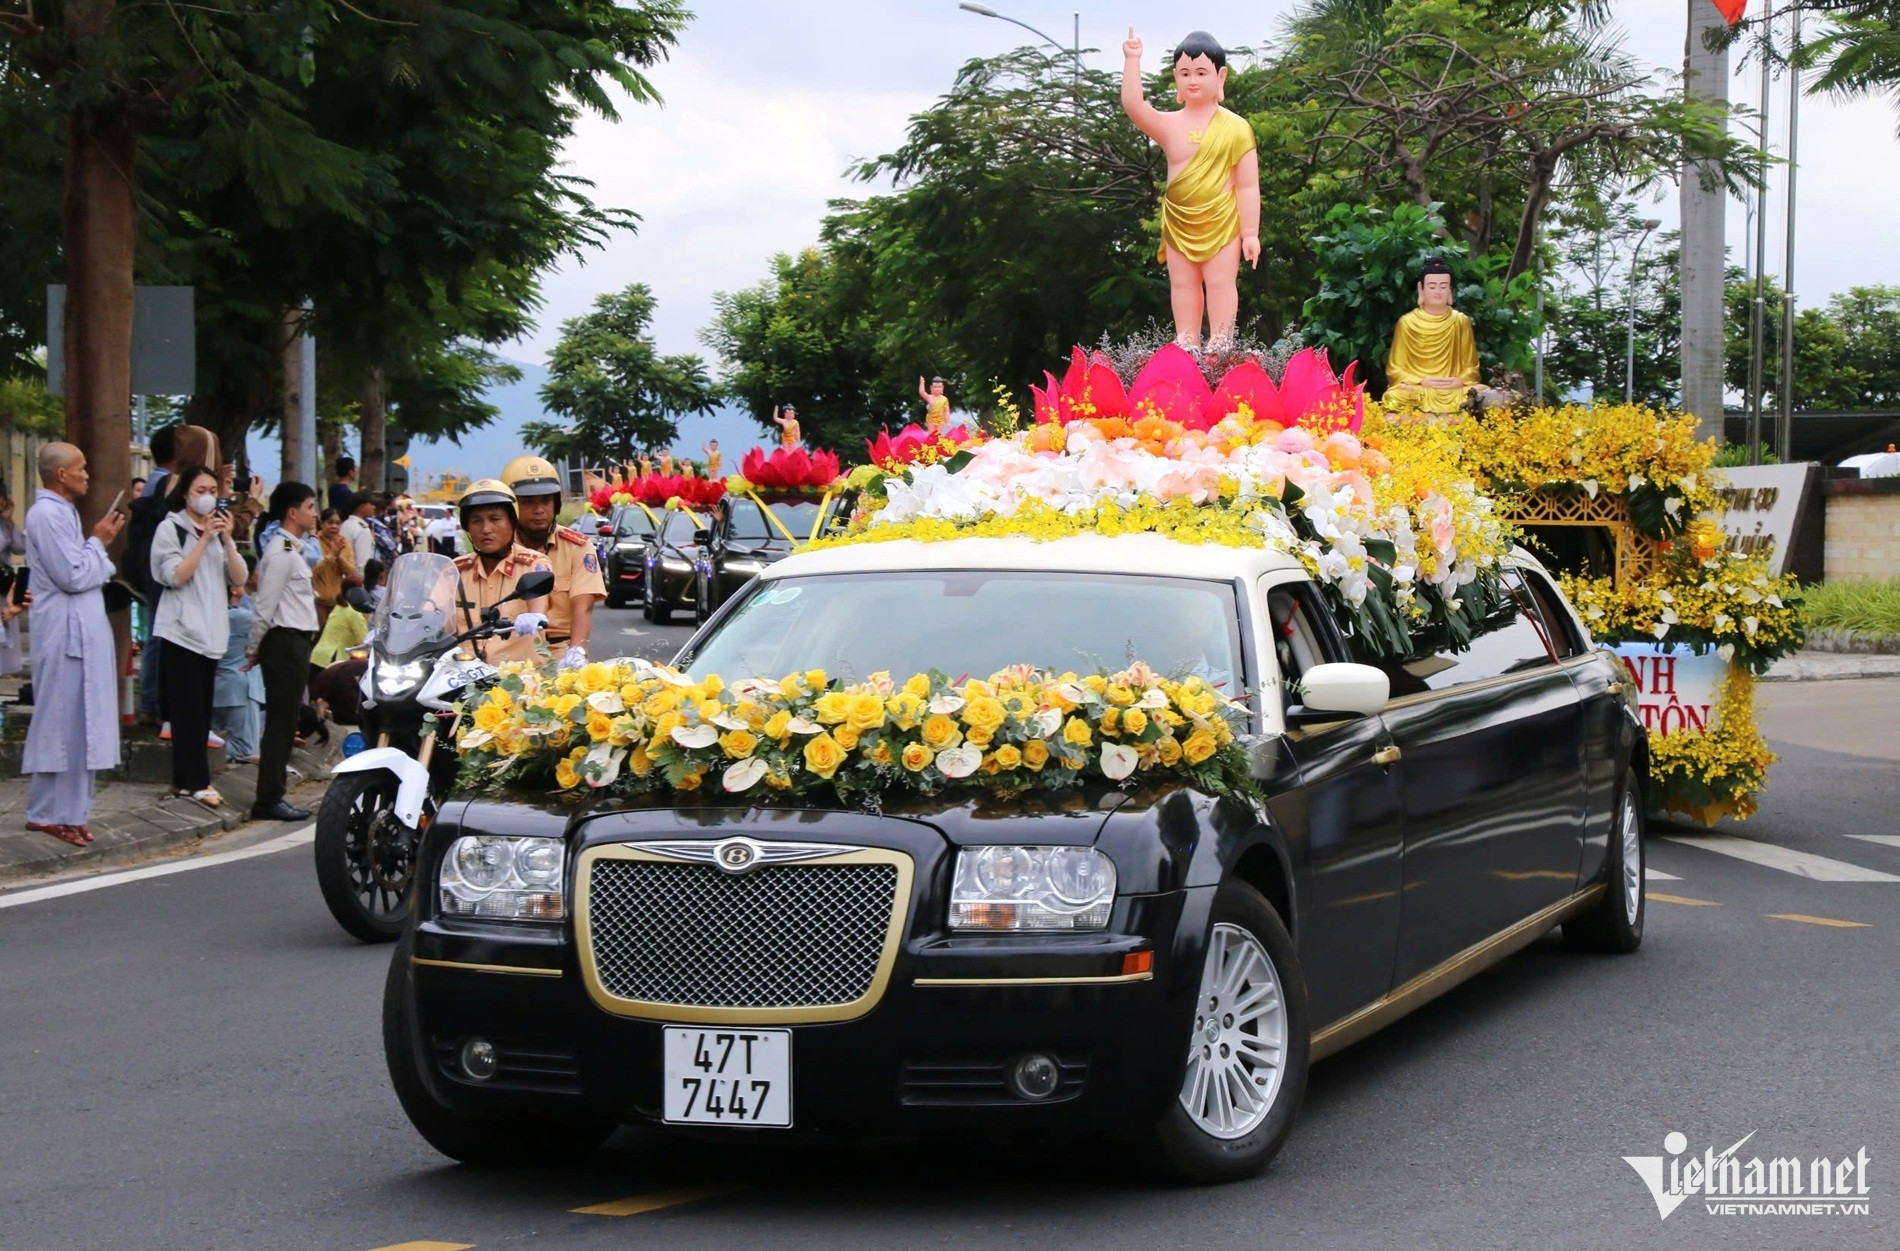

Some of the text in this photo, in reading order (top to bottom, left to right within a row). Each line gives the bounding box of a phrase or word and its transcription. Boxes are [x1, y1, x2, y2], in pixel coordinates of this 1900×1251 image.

[447, 666, 486, 689] CSGT
[1638, 694, 1711, 740] TÔN
[726, 848, 748, 864] B
[694, 1033, 758, 1075] 47T
[682, 1077, 771, 1120] 7447
